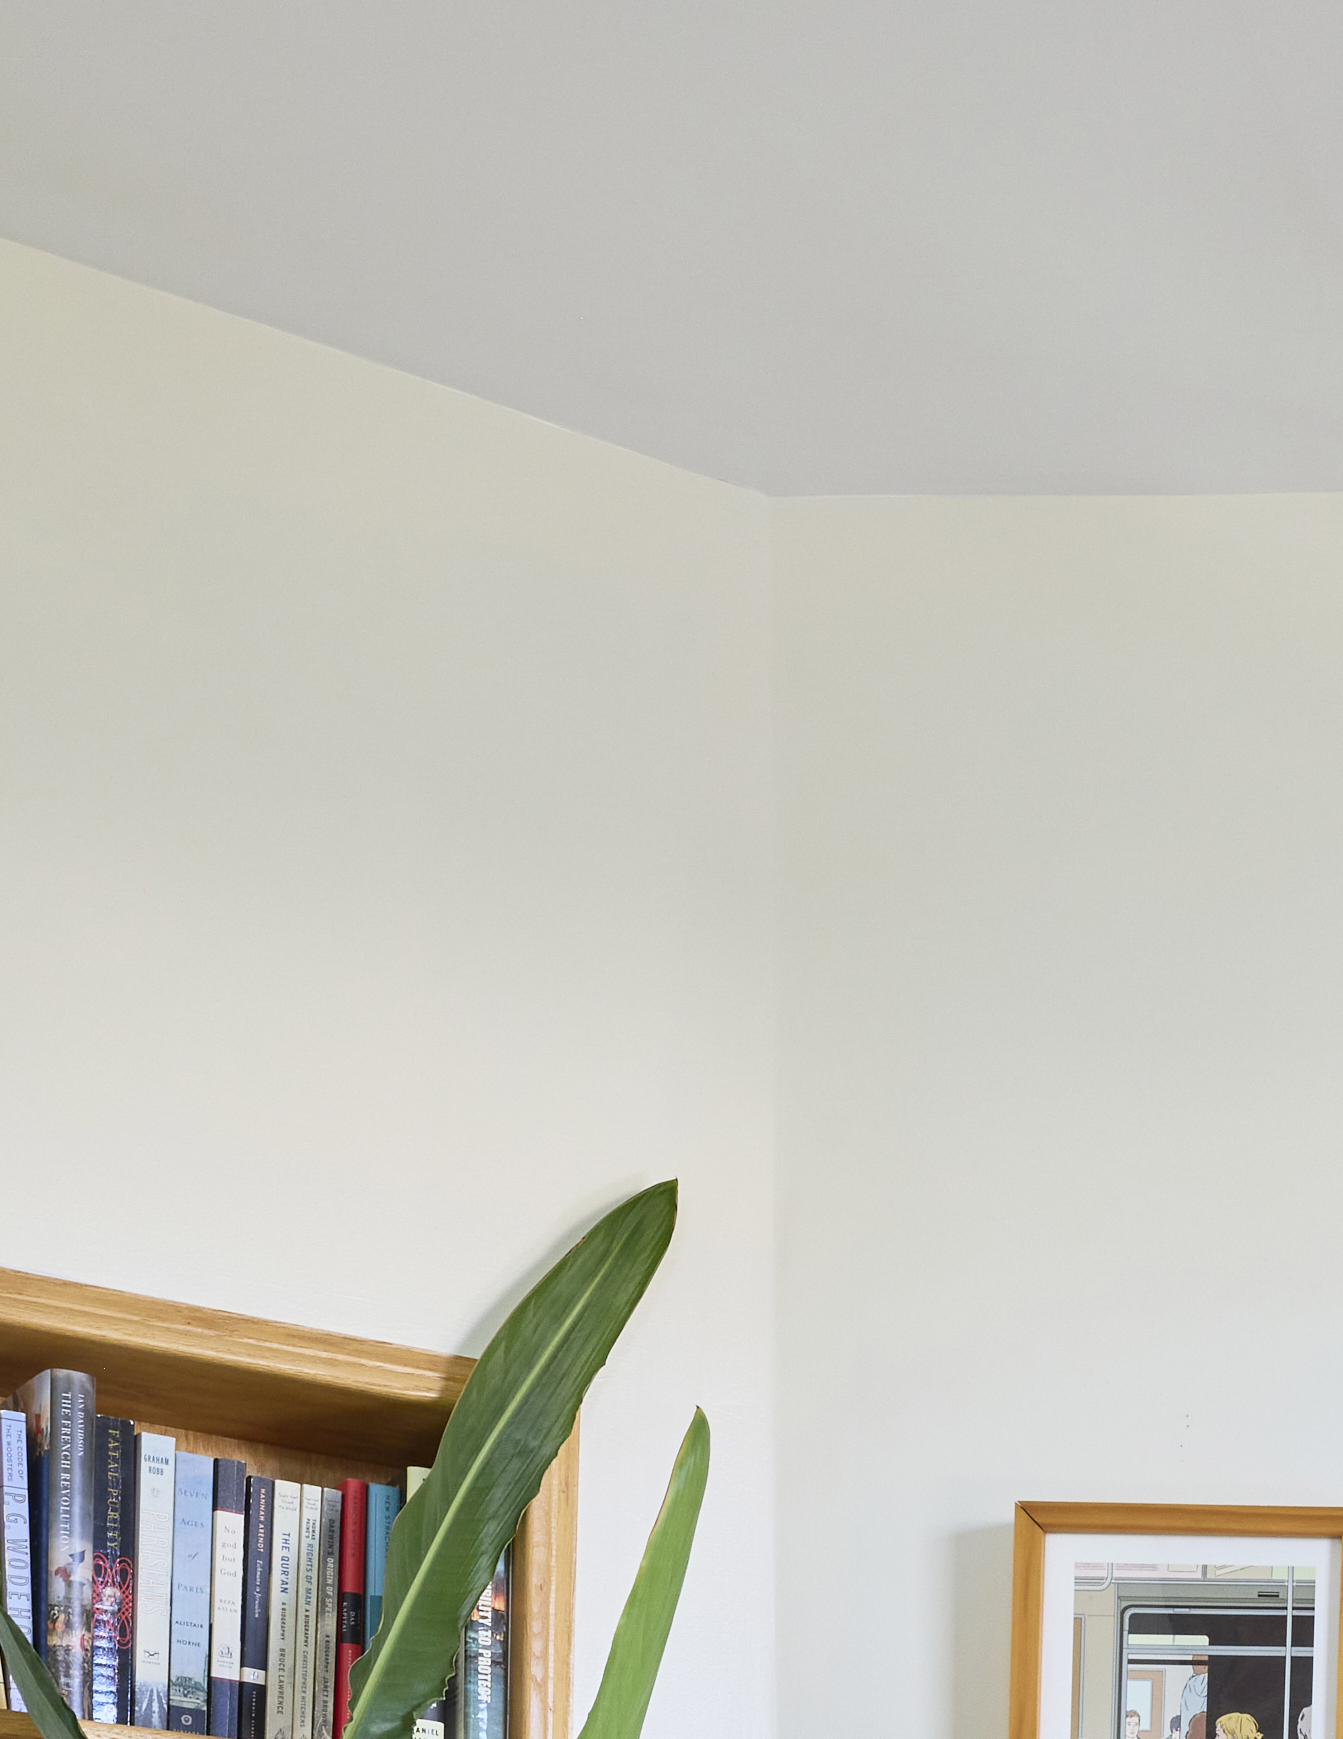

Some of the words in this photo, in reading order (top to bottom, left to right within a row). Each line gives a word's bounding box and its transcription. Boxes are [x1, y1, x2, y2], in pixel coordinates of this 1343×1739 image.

[61, 1392, 72, 1417] THE
[61, 1420, 72, 1468] FRENCH
[108, 1429, 120, 1480] FATAL
[6, 1442, 14, 1482] WOOSTERS
[144, 1454, 169, 1466] GRAHAM
[149, 1466, 164, 1476] ROBB
[18, 1469, 24, 1481] OF
[178, 1487, 208, 1500] SEVEN
[60, 1473, 71, 1552] REVOLUTION
[258, 1489, 266, 1522] HANNAH
[108, 1488, 118, 1549] PURITY
[180, 1518, 205, 1529] AGES
[224, 1526, 236, 1534] No
[257, 1524, 265, 1552] ARENDT
[327, 1519, 335, 1556] DARWIN'S
[222, 1541, 237, 1550] god
[281, 1532, 290, 1551] THE
[188, 1552, 198, 1562] of
[222, 1554, 236, 1563] but
[305, 1543, 314, 1572] RIGHTS
[219, 1568, 237, 1578] God
[255, 1560, 263, 1585] Eichmann
[278, 1555, 290, 1594] QUR'AN
[305, 1575, 313, 1585] OF
[326, 1558, 334, 1583] ORIGIN
[177, 1582, 204, 1594] PARIS
[304, 1588, 312, 1606] MAN
[325, 1586, 334, 1596] OF
[217, 1605, 238, 1613] ASLAN
[324, 1598, 333, 1629] SPECIES
[175, 1620, 204, 1629] ALISTAIR
[177, 1639, 201, 1648] HORNE
[278, 1648, 286, 1672] BRUCE
[300, 1650, 308, 1694] CHRISTOPHER
[277, 1675, 285, 1715] LAWRENCE
[322, 1677, 330, 1697] JANET
[300, 1695, 308, 1728] HITCHENS
[321, 1699, 329, 1728] BROWNE
